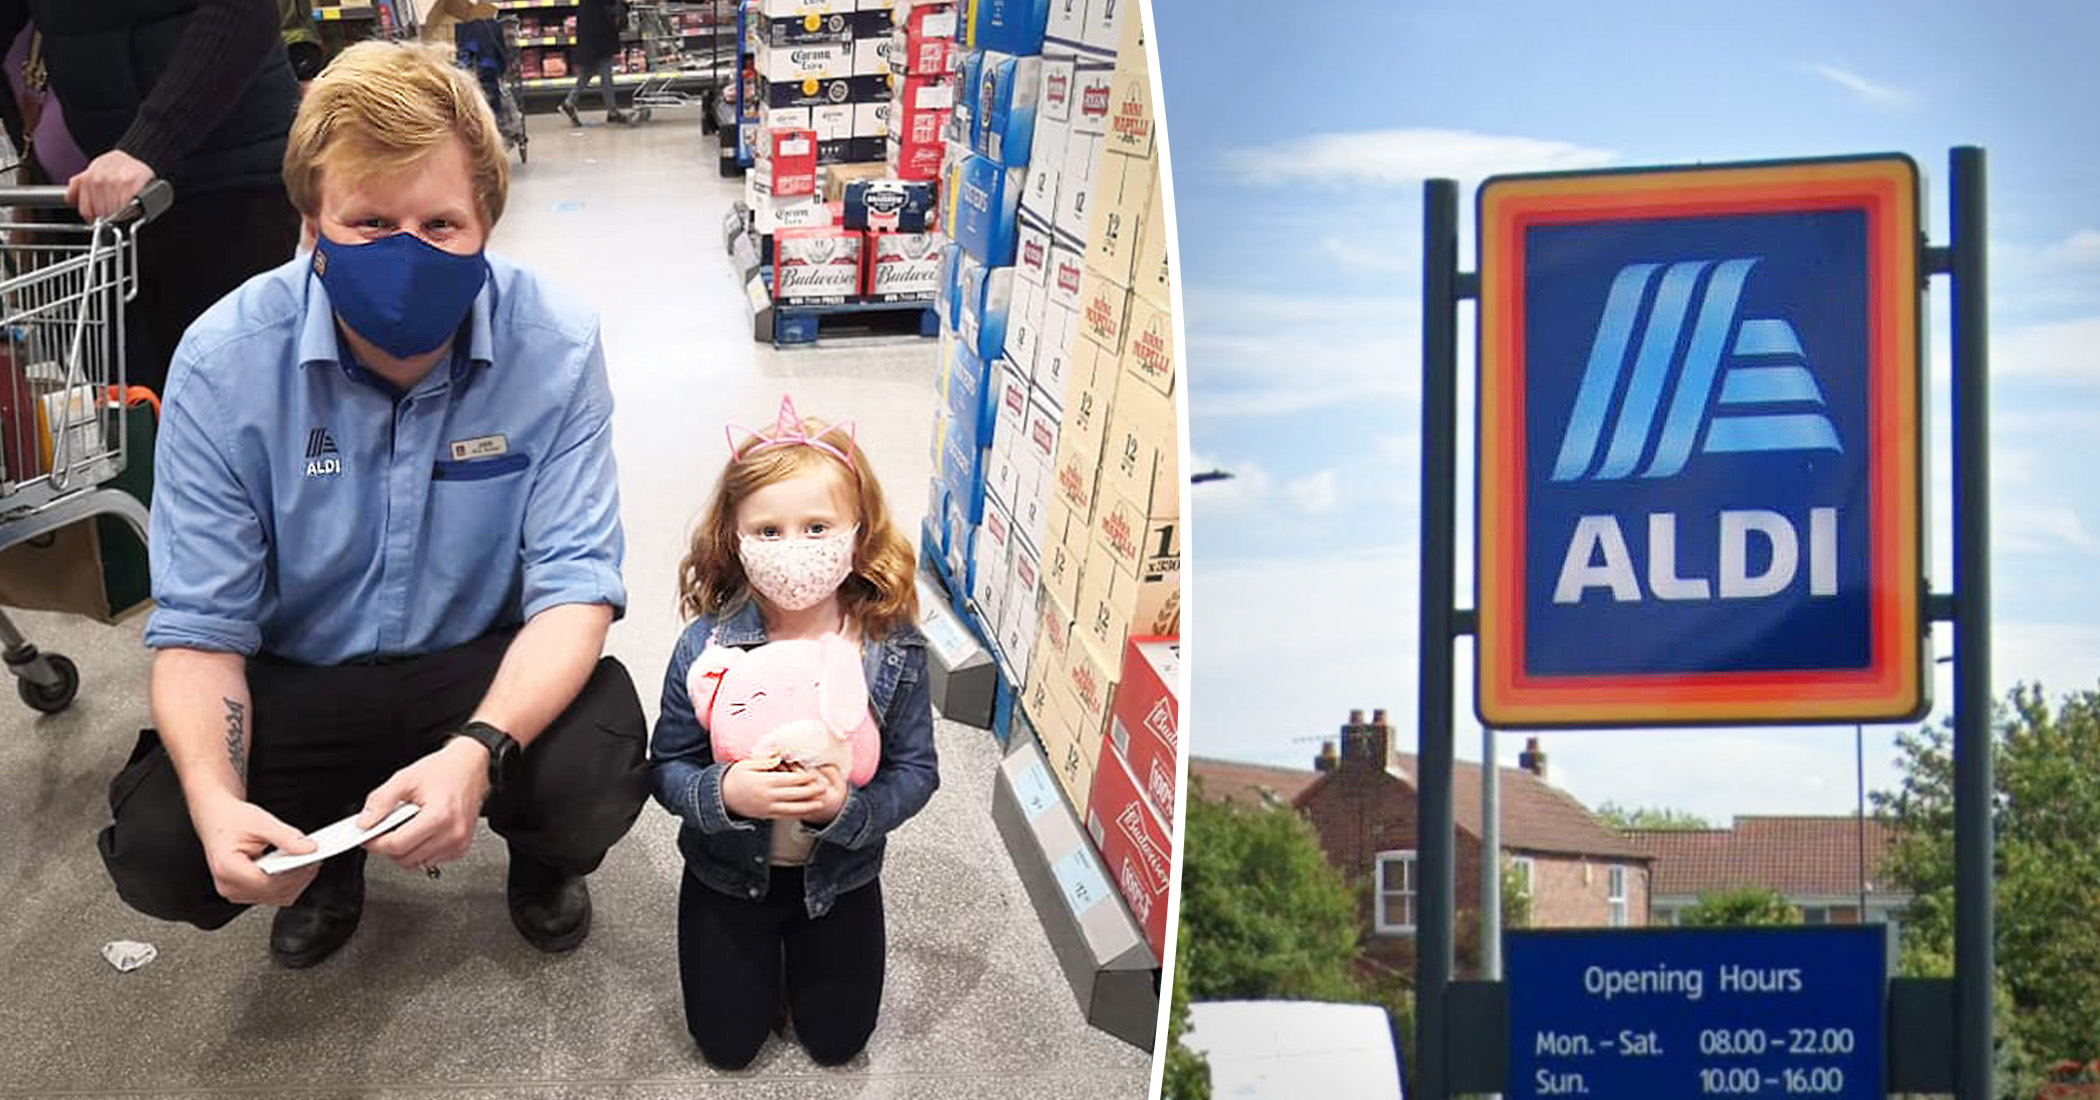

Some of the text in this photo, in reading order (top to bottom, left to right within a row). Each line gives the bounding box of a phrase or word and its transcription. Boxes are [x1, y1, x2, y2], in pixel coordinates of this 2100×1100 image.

[790, 49, 831, 65] Corona
[1105, 212, 1120, 240] 12
[1125, 432, 1138, 462] 12
[305, 458, 342, 477] ALDI
[1552, 506, 1838, 604] ALDI
[1584, 963, 1803, 1000] Opening Hours
[1535, 1030, 1595, 1055] Mon.
[1618, 1030, 1664, 1055] Sat.
[1699, 1029, 1766, 1054] 08.00
[1787, 1028, 1855, 1053] 22.00
[1535, 1068, 1590, 1094] Sun.
[1699, 1067, 1760, 1093] 10.00
[1782, 1067, 1844, 1093] 16.00
